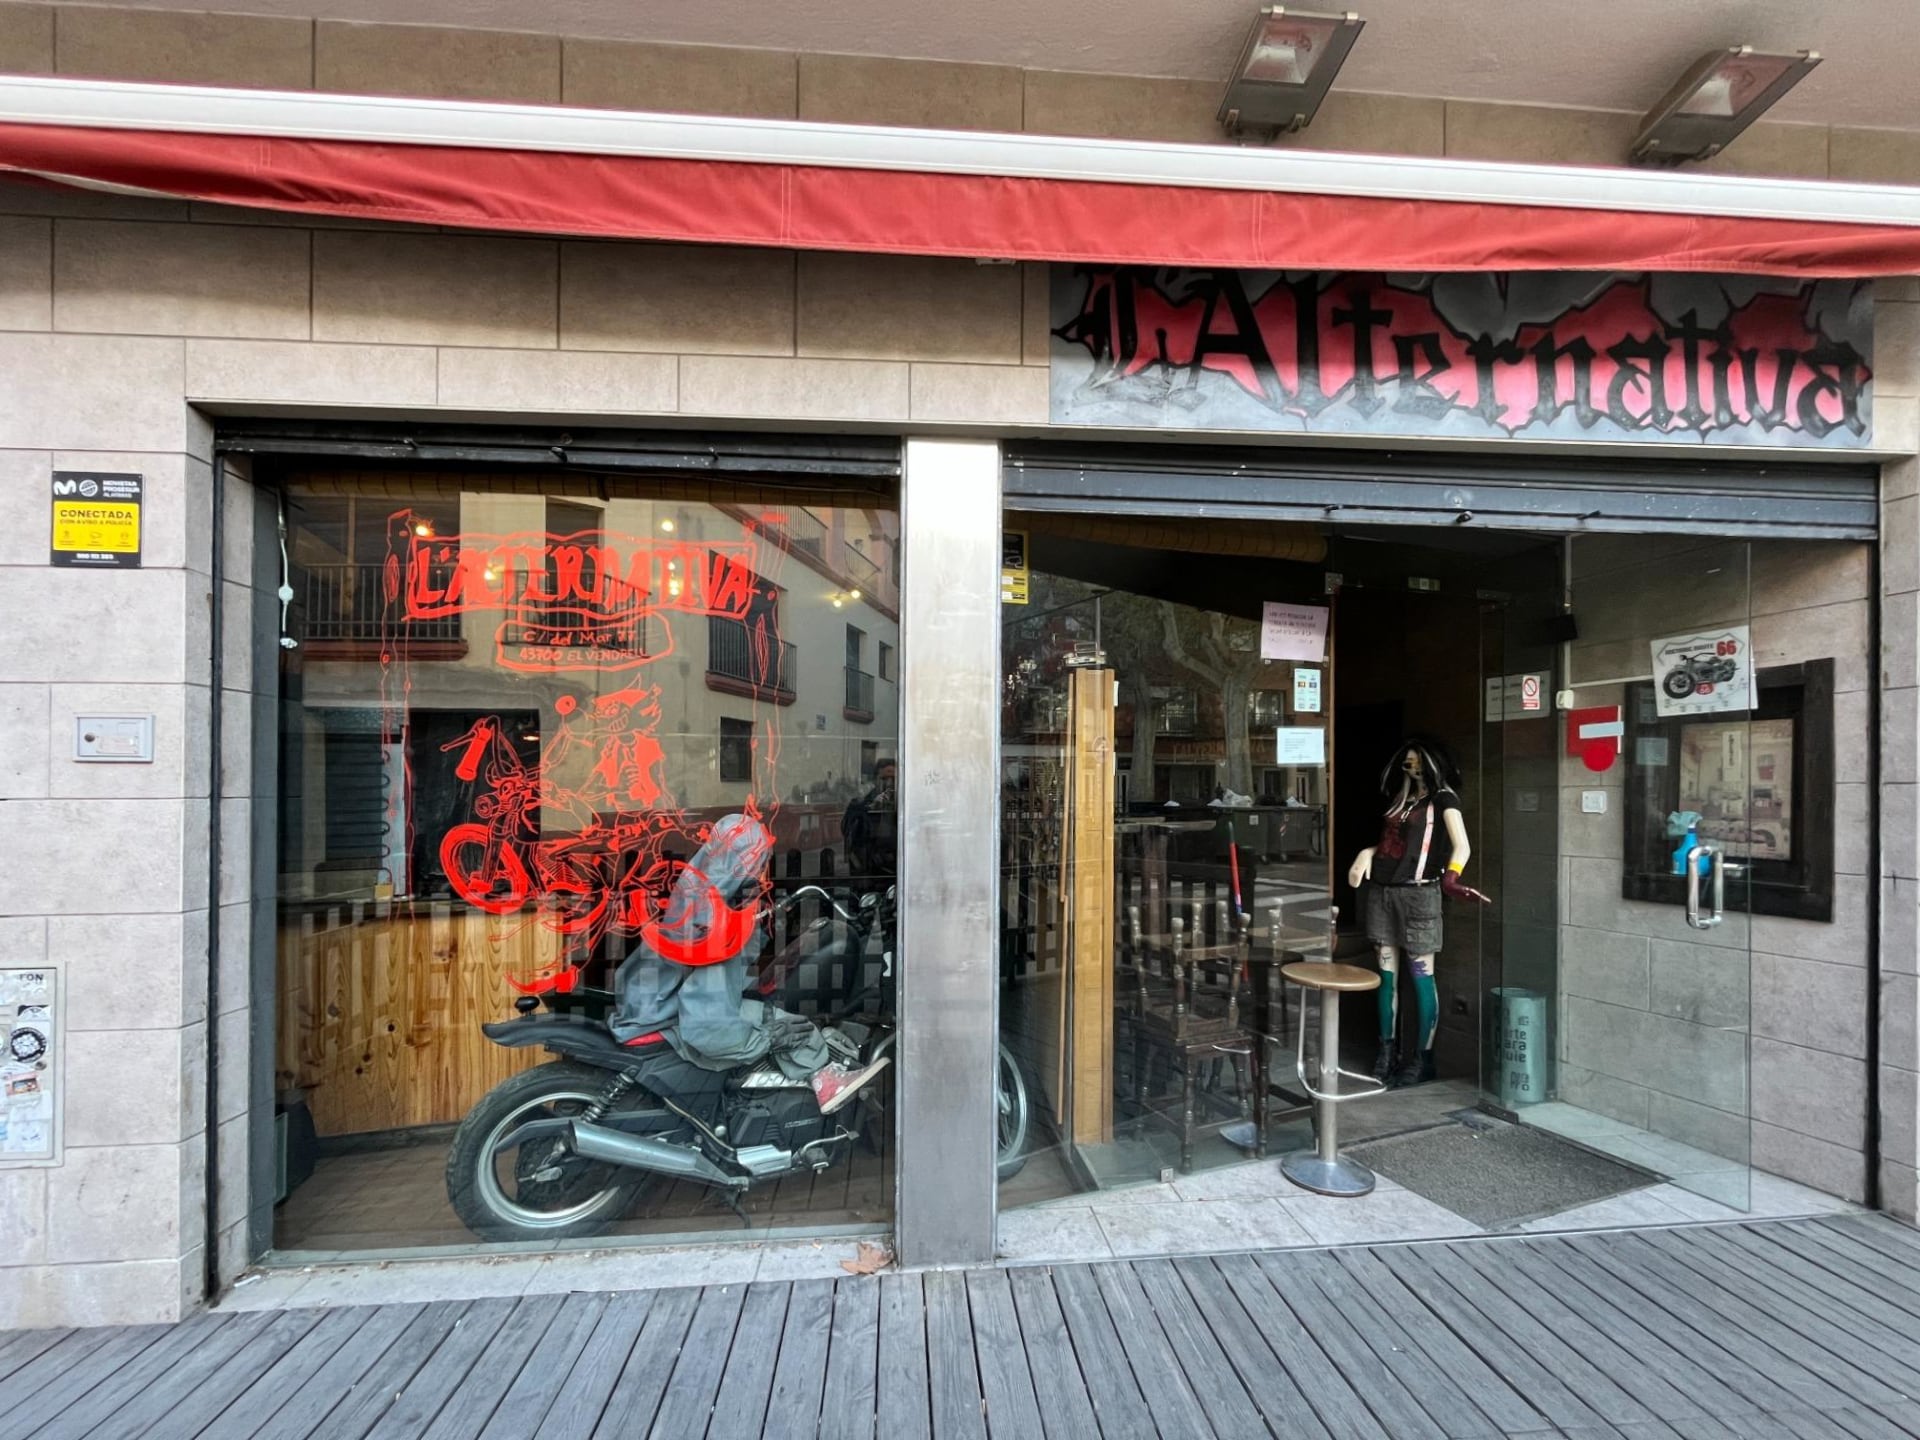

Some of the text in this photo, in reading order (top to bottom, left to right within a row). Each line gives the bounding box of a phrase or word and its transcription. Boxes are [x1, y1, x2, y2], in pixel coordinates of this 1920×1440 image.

[60, 509, 133, 520] CONECTADA
[551, 632, 572, 645] del
[580, 631, 612, 644] Mar
[567, 649, 582, 662] EL
[586, 648, 648, 661] VENDRELL
[1717, 640, 1737, 656] 66
